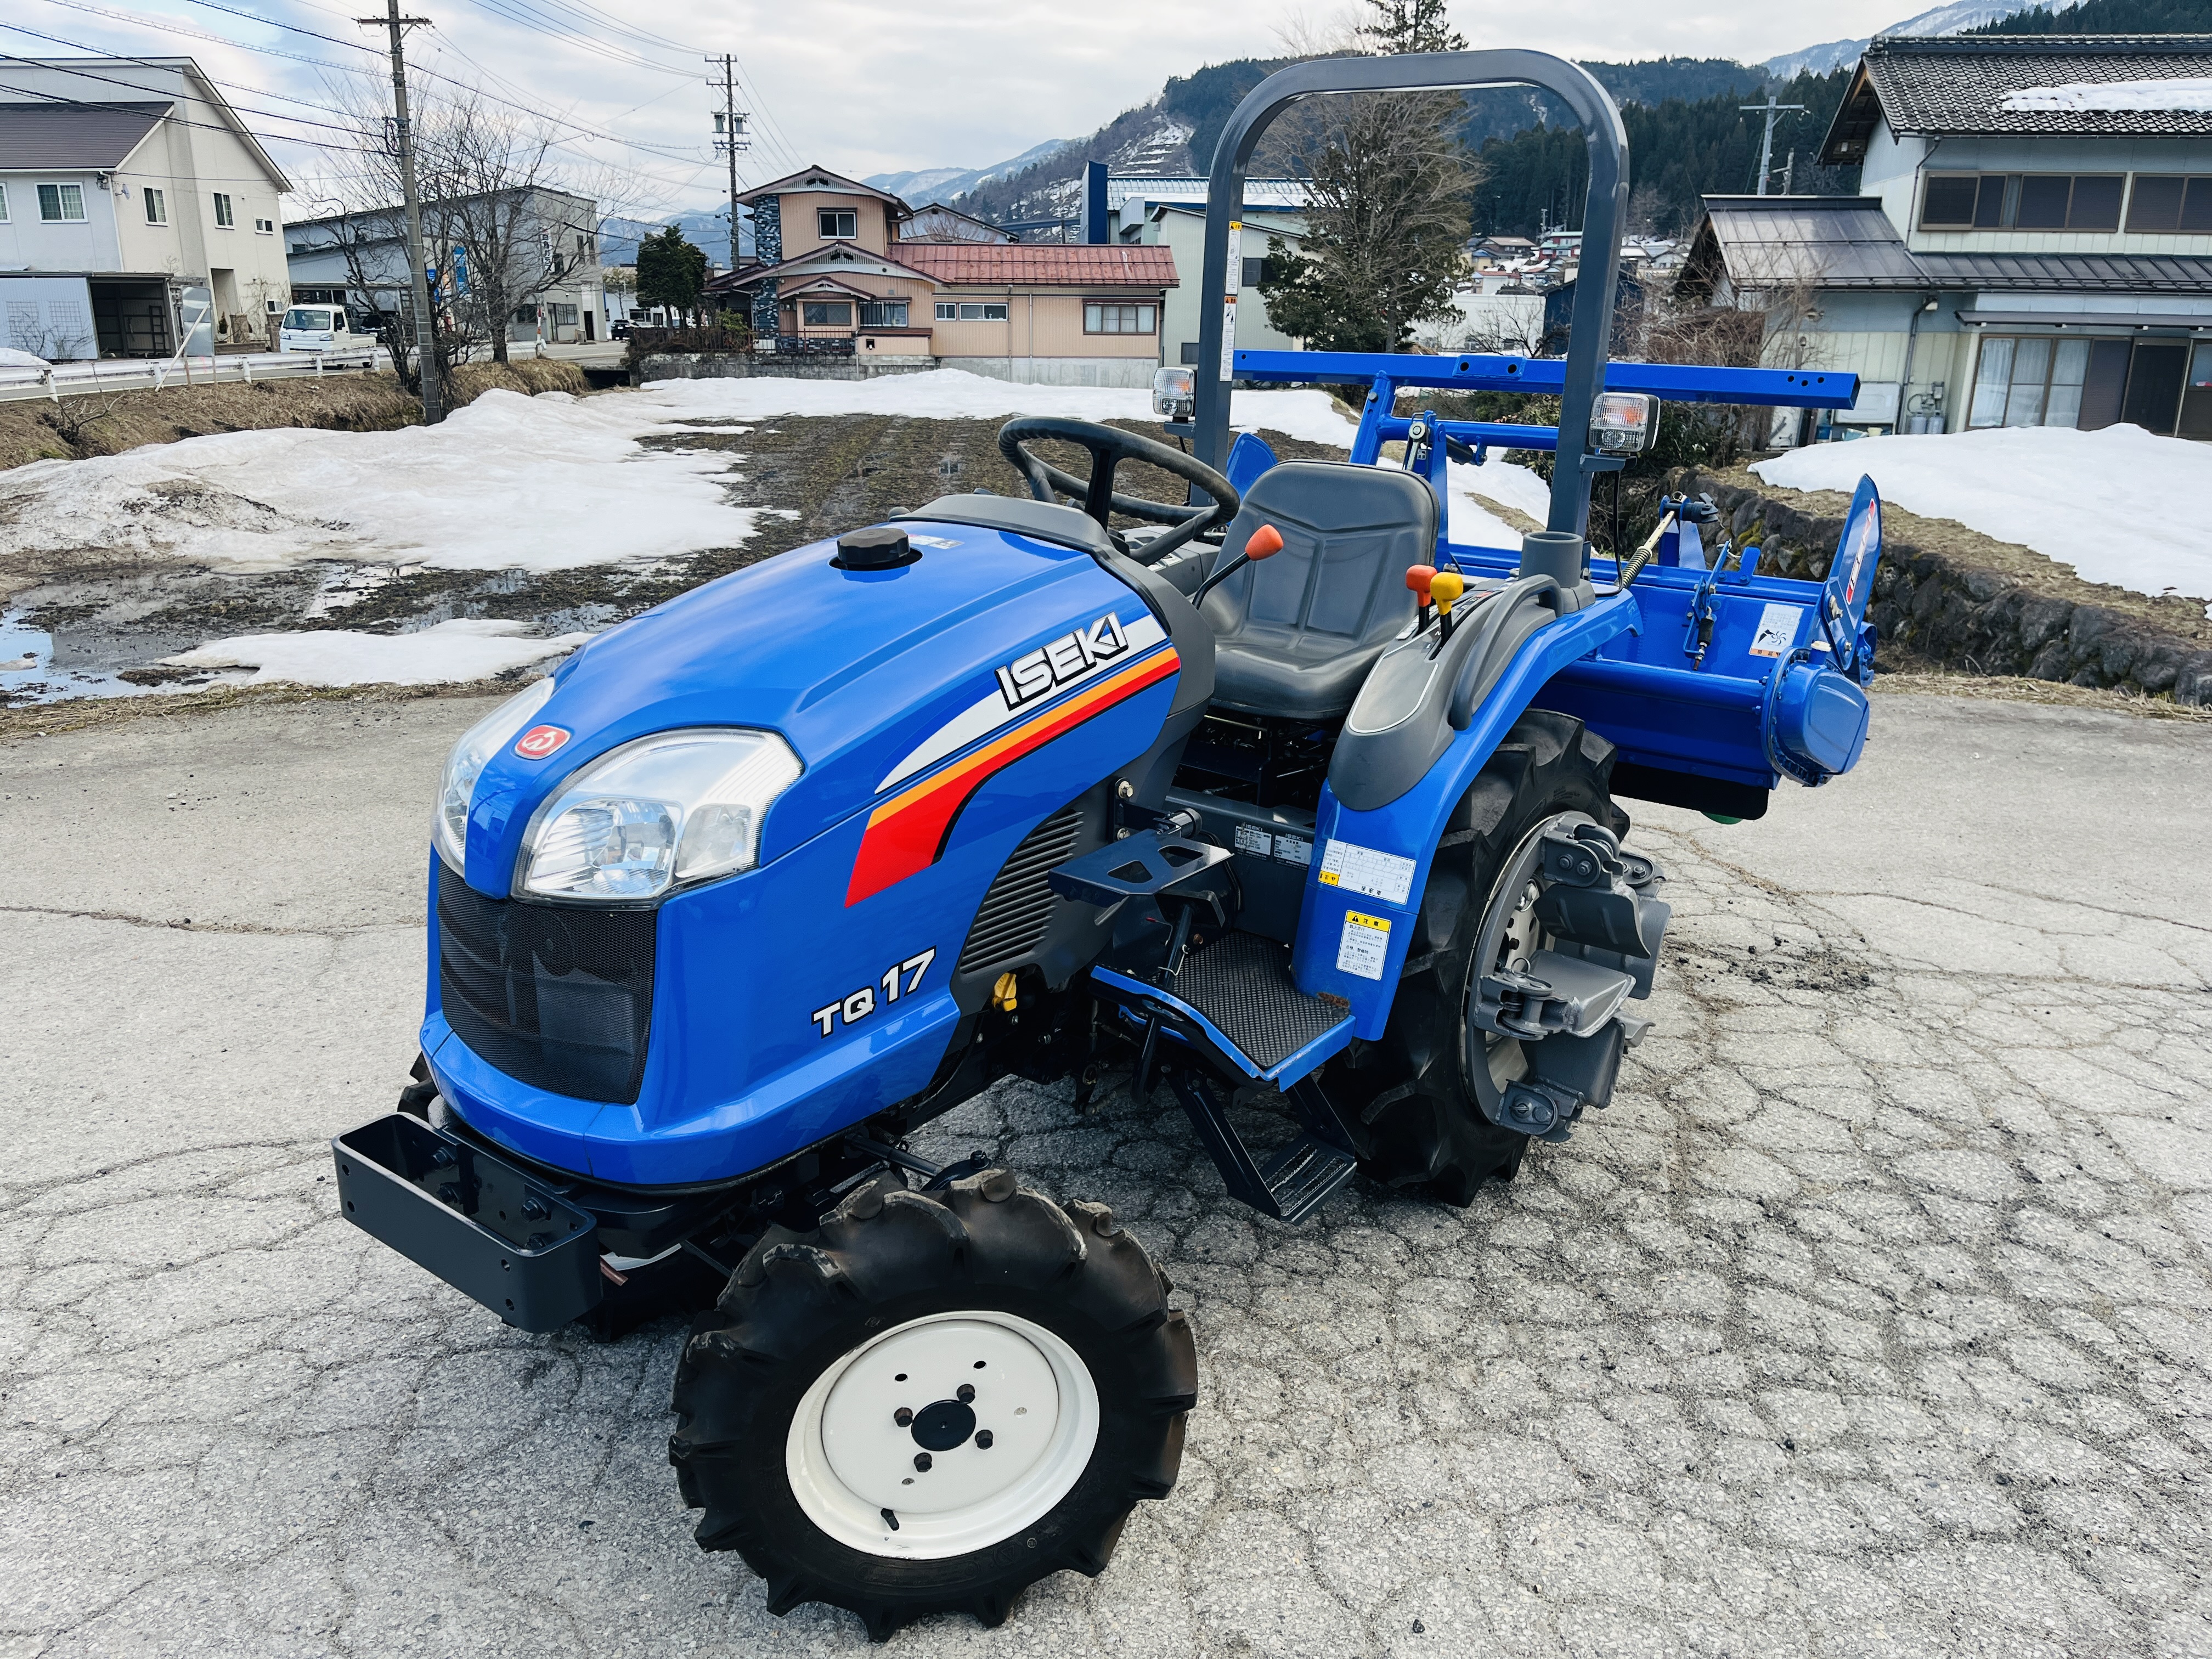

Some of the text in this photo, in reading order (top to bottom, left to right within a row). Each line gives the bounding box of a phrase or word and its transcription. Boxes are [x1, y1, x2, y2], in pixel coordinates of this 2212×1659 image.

[995, 612, 1128, 712] ISEKI
[1245, 823, 1263, 832] ISEKI
[1285, 833, 1304, 842] ISEKI
[1363, 918, 1379, 927] 注意
